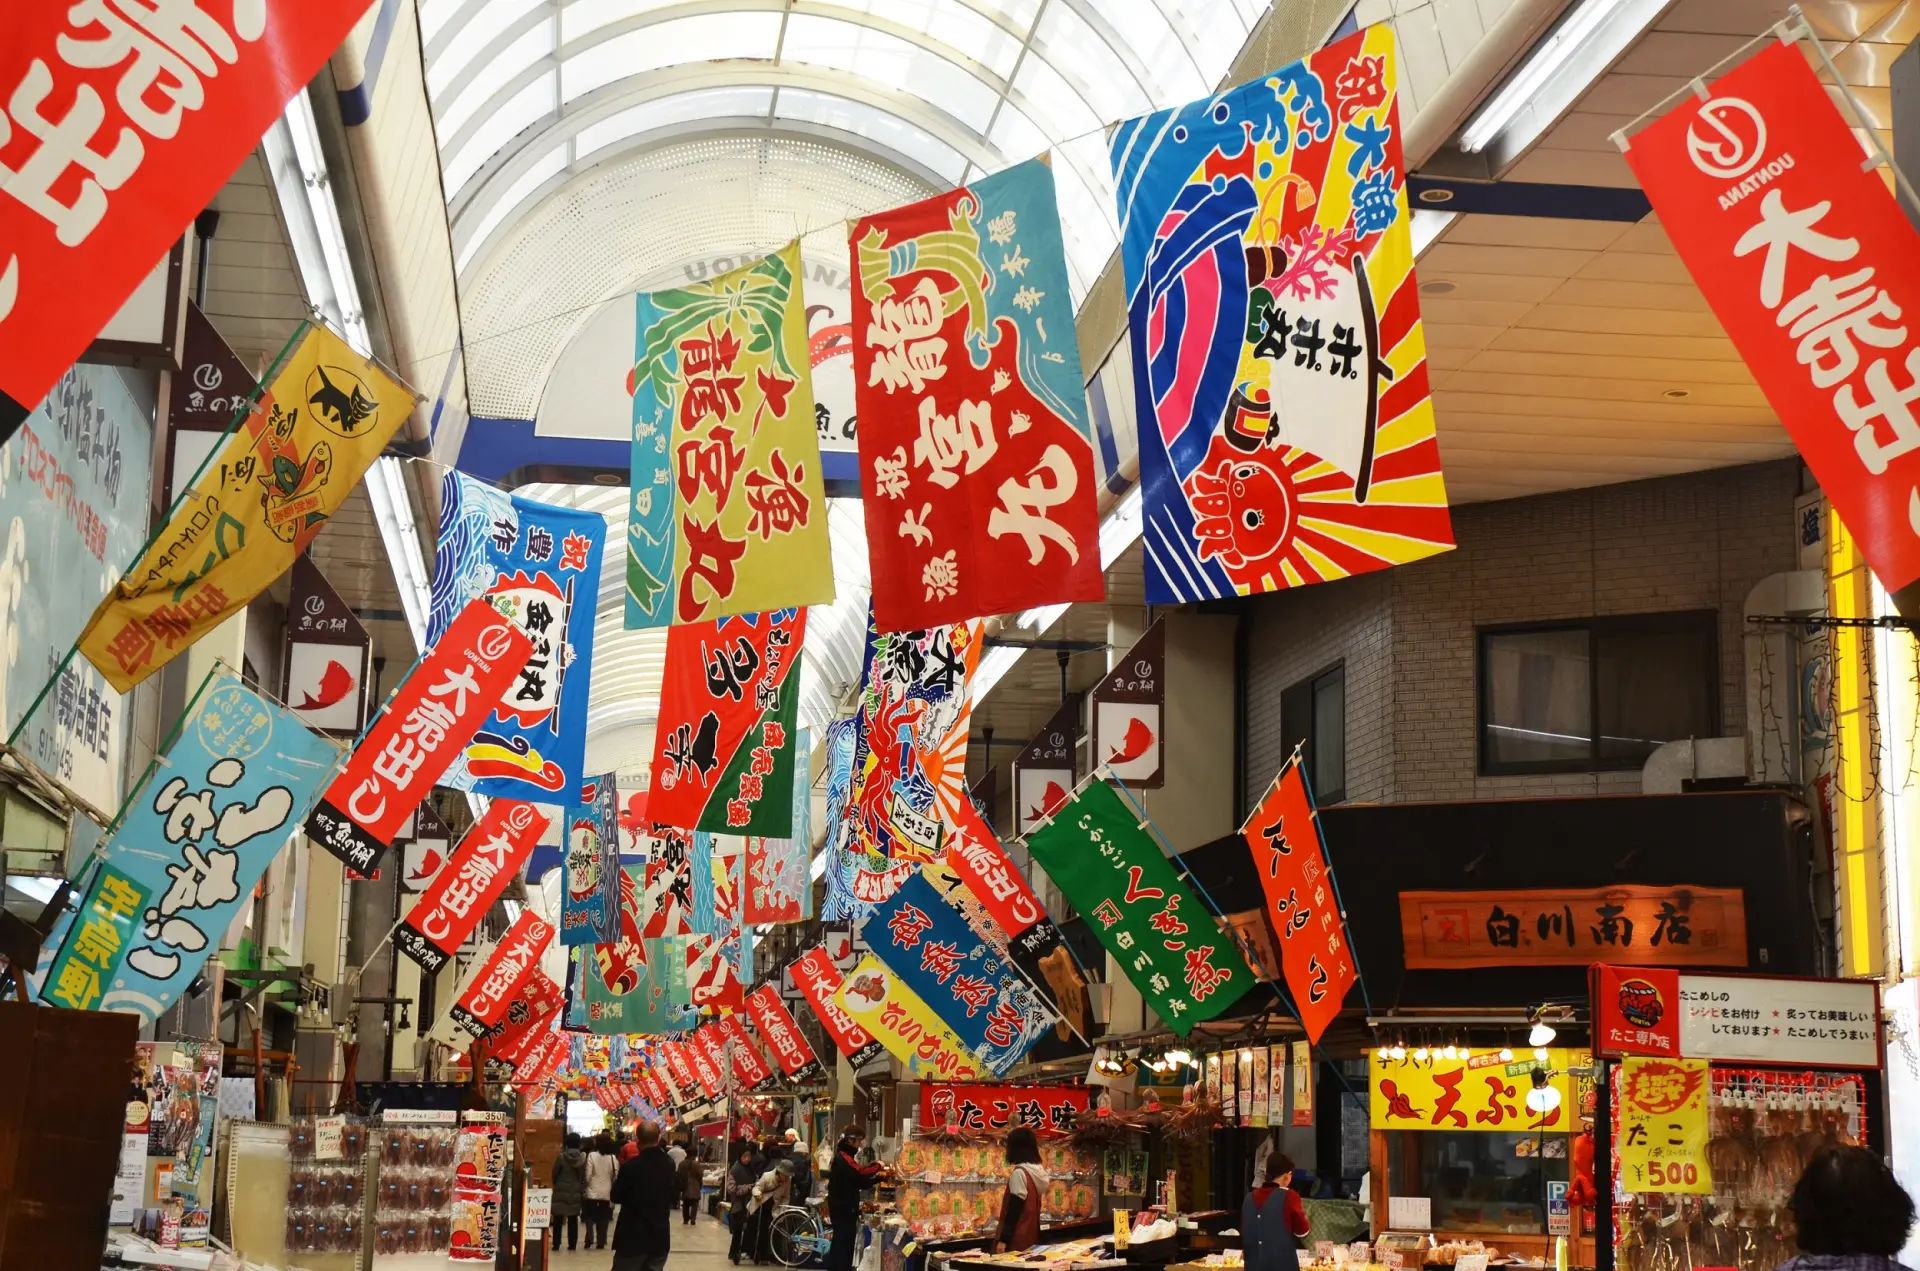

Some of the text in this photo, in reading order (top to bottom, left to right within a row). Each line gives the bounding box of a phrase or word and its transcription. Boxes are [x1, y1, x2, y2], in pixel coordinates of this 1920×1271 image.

[1334, 53, 1398, 240] 祝大漁
[1255, 305, 1363, 380] ポポ丸
[867, 277, 1080, 567] 龍宮丸
[677, 320, 747, 624] 龍宮丸
[744, 369, 810, 541] 大漁
[493, 518, 592, 572] 祝豊作
[876, 445, 958, 603] 祝大漁
[463, 648, 493, 675] UONTANA
[348, 664, 481, 824] 大売出し
[727, 721, 786, 827] 商売繁盛
[316, 812, 375, 870] 明石 魚の棚
[423, 832, 514, 939] 大売出し
[1485, 900, 1694, 949] 白川南店
[470, 941, 534, 1017] 大売出し
[1680, 990, 1730, 1002] たこめしの
[1610, 1028, 1671, 1050] たこ専門店
[1691, 1007, 1760, 1020] レシピをお付け
[1712, 1024, 1771, 1037] しております
[1635, 1069, 1686, 1104] 超安
[959, 1100, 1077, 1129] たこ珍味
[1627, 1123, 1684, 1146] たこ
[1552, 1184, 1566, 1199] P
[1632, 1161, 1698, 1186] ¥500
